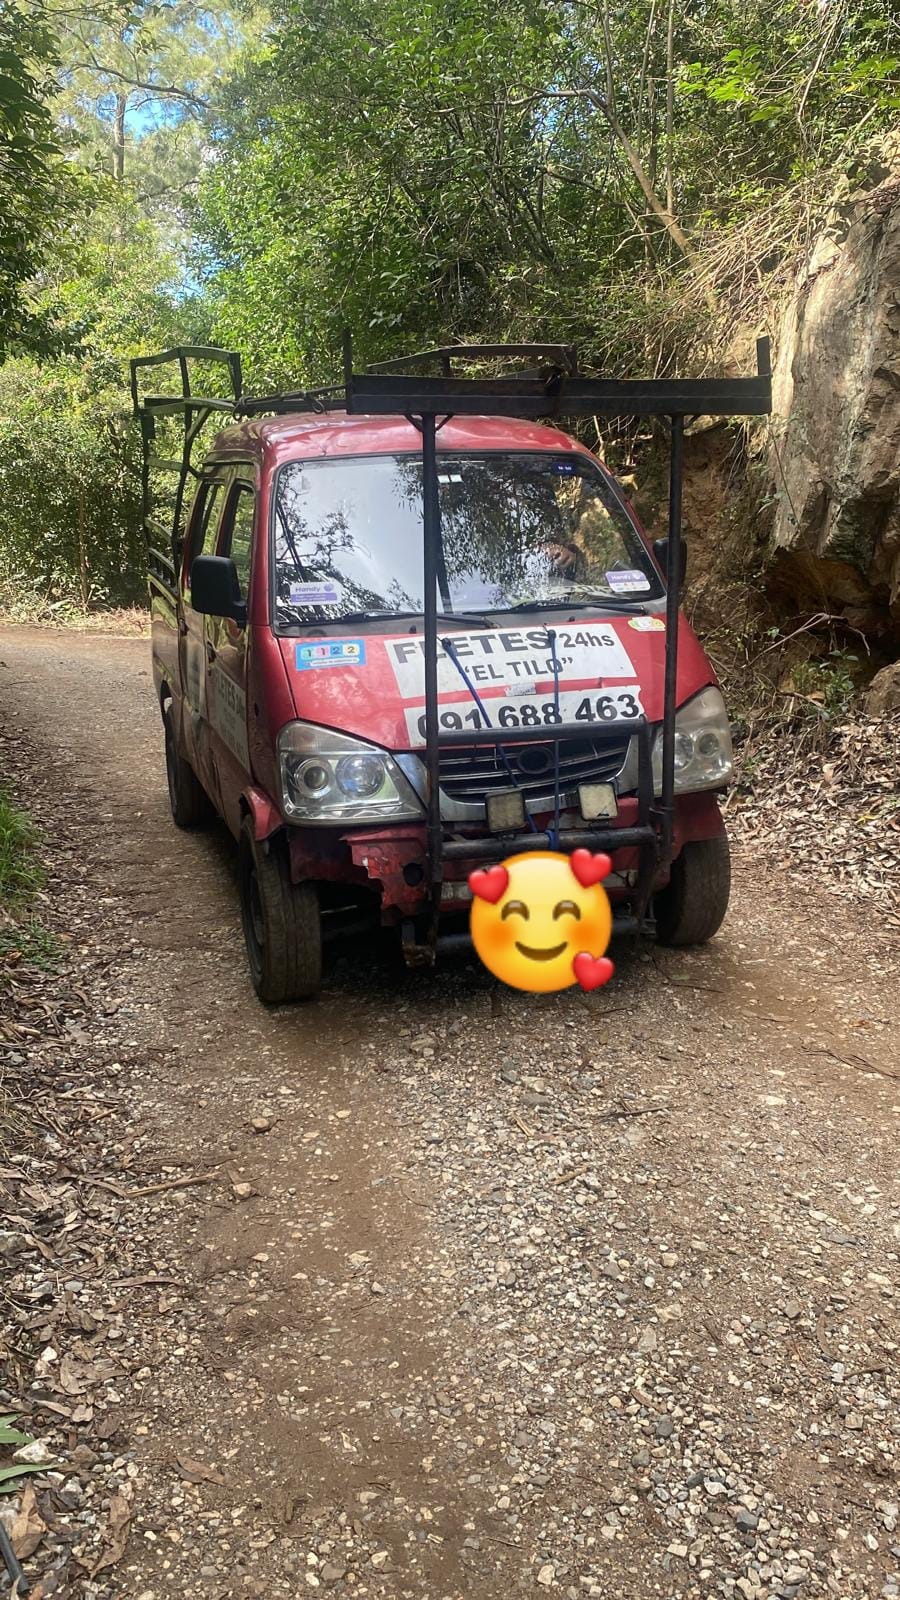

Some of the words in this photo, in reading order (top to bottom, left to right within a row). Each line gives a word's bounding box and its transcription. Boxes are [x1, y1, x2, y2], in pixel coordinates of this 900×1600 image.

[558, 632, 615, 648] 24hs
[498, 702, 562, 728] 688
[575, 693, 640, 722] 463
